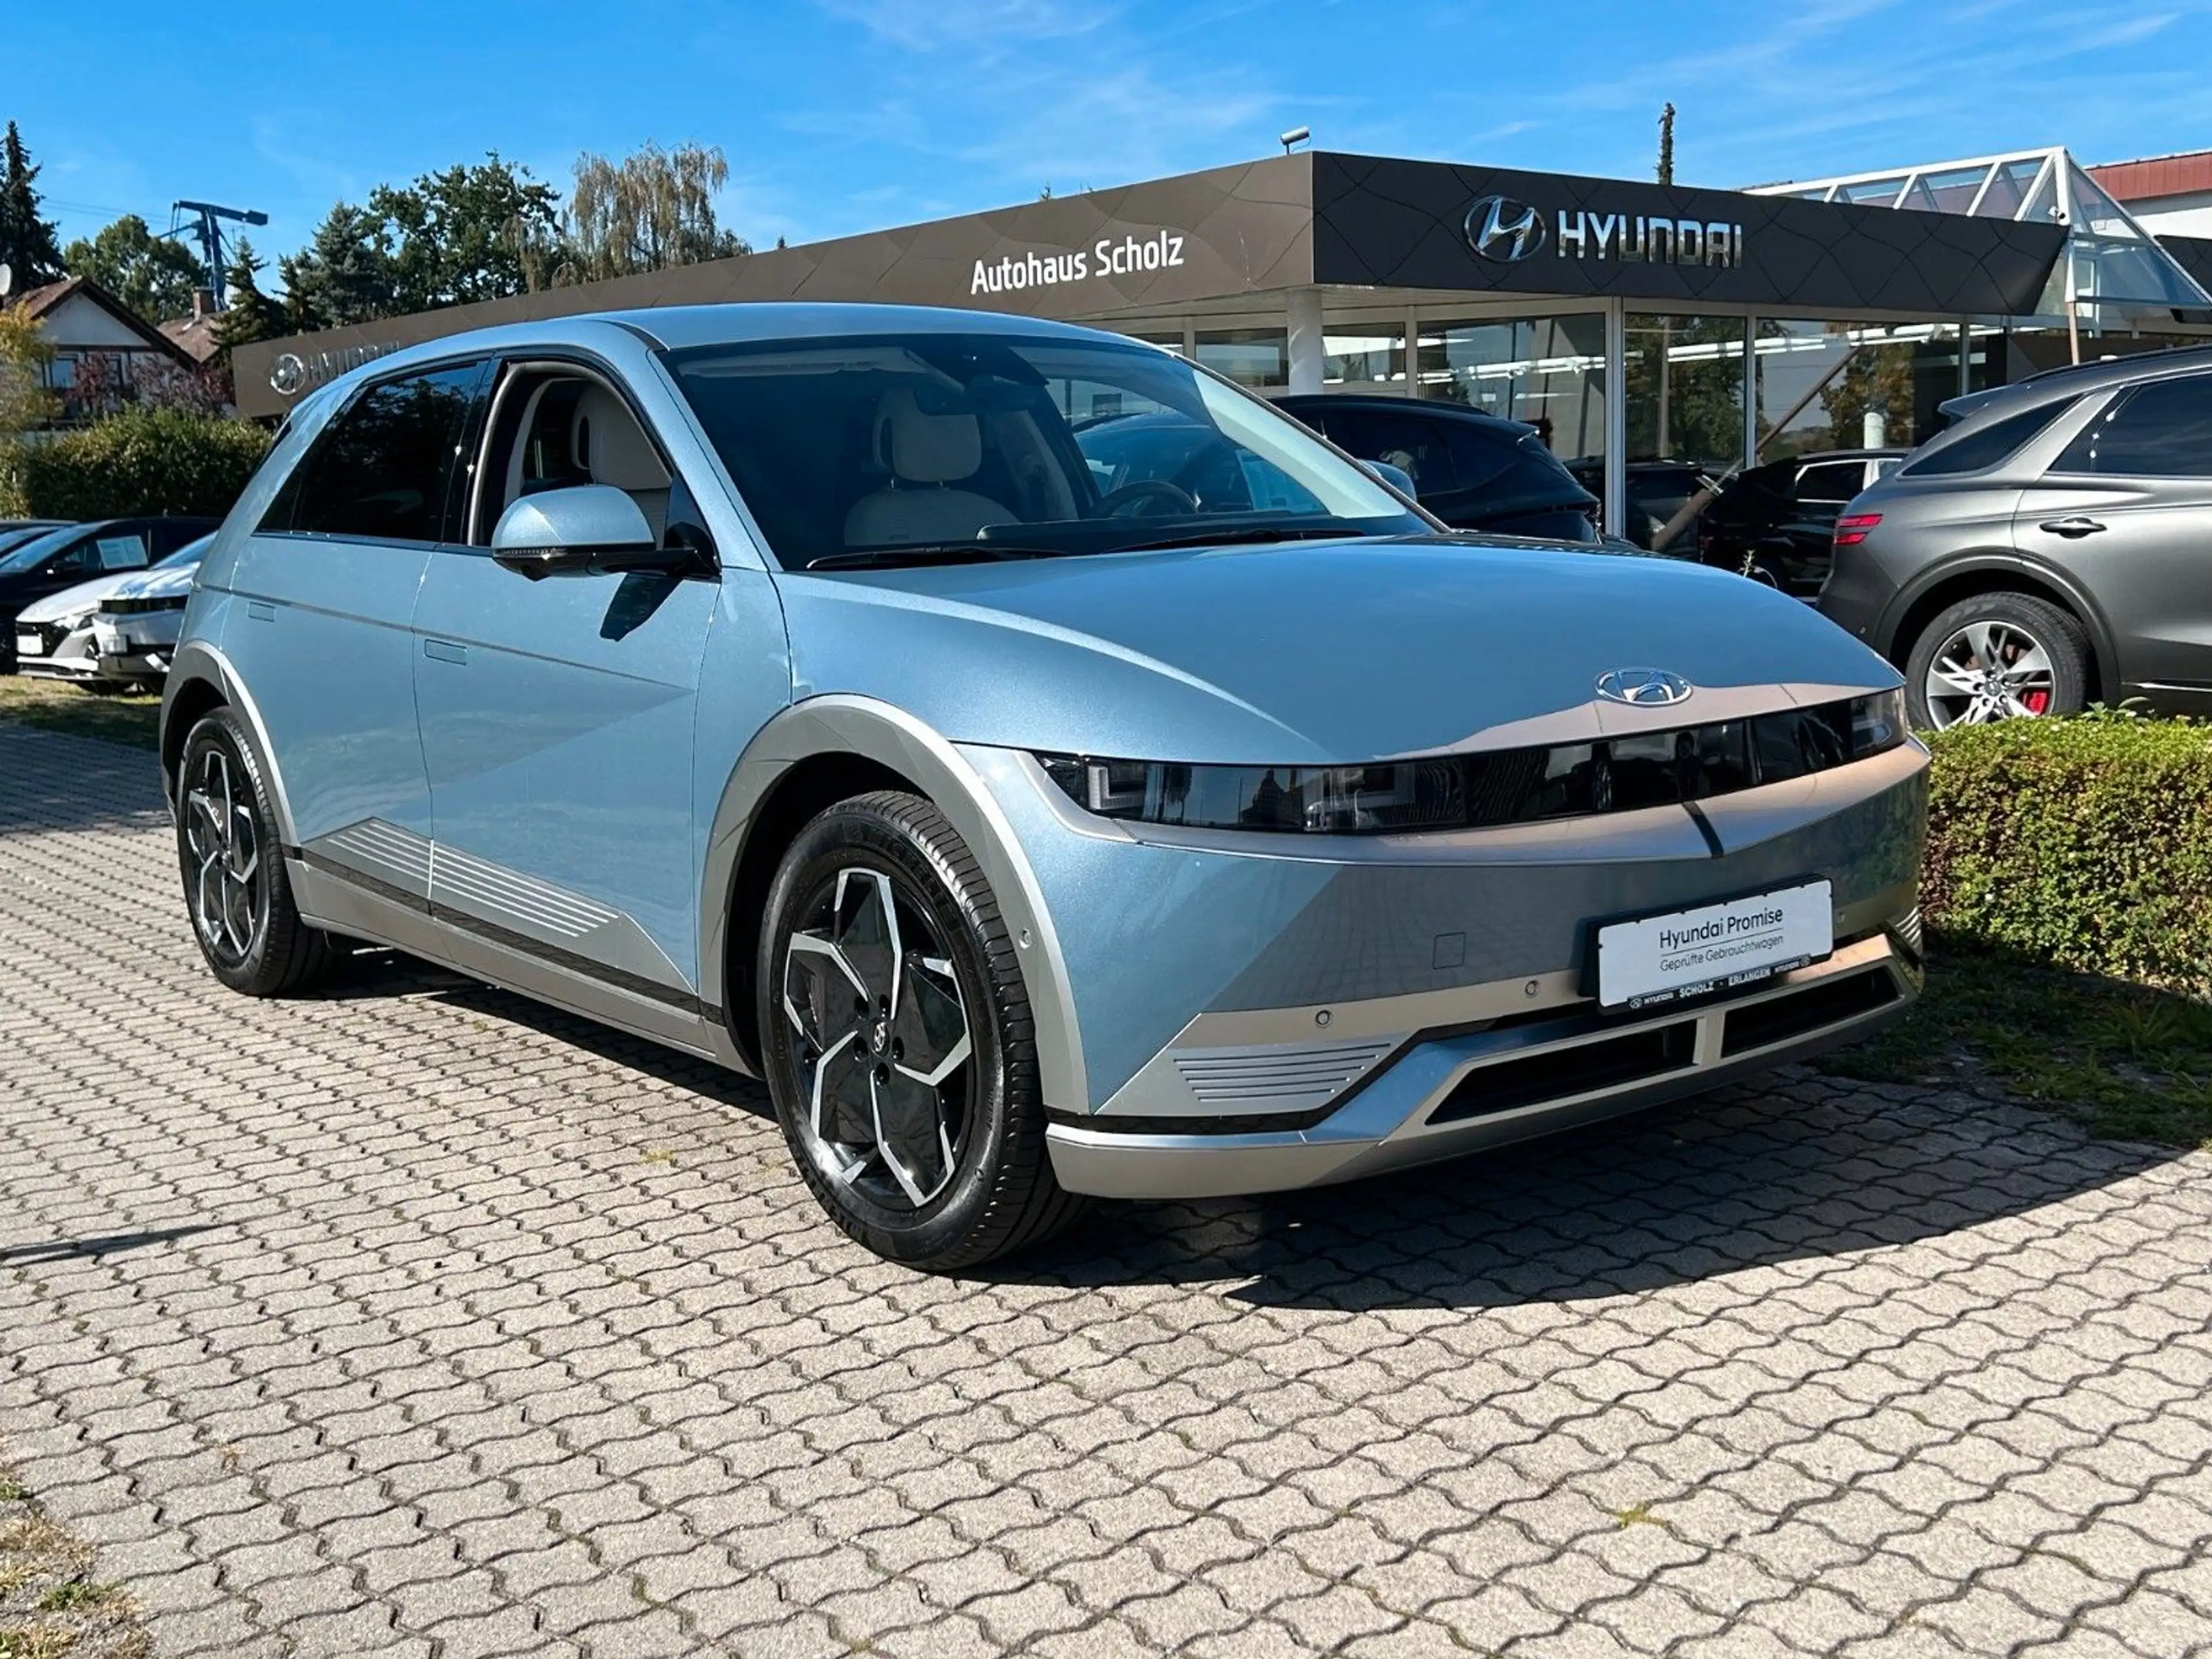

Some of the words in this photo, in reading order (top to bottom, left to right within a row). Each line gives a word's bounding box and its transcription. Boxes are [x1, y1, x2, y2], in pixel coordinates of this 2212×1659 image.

[970, 251, 1088, 295] Autohaus
[1094, 230, 1184, 278] Scholz
[1558, 210, 1742, 269] HYUNDAI
[1660, 918, 1724, 949] Hyundai
[1727, 907, 1783, 934] Promise
[1679, 980, 1714, 998] SCHOLZ
